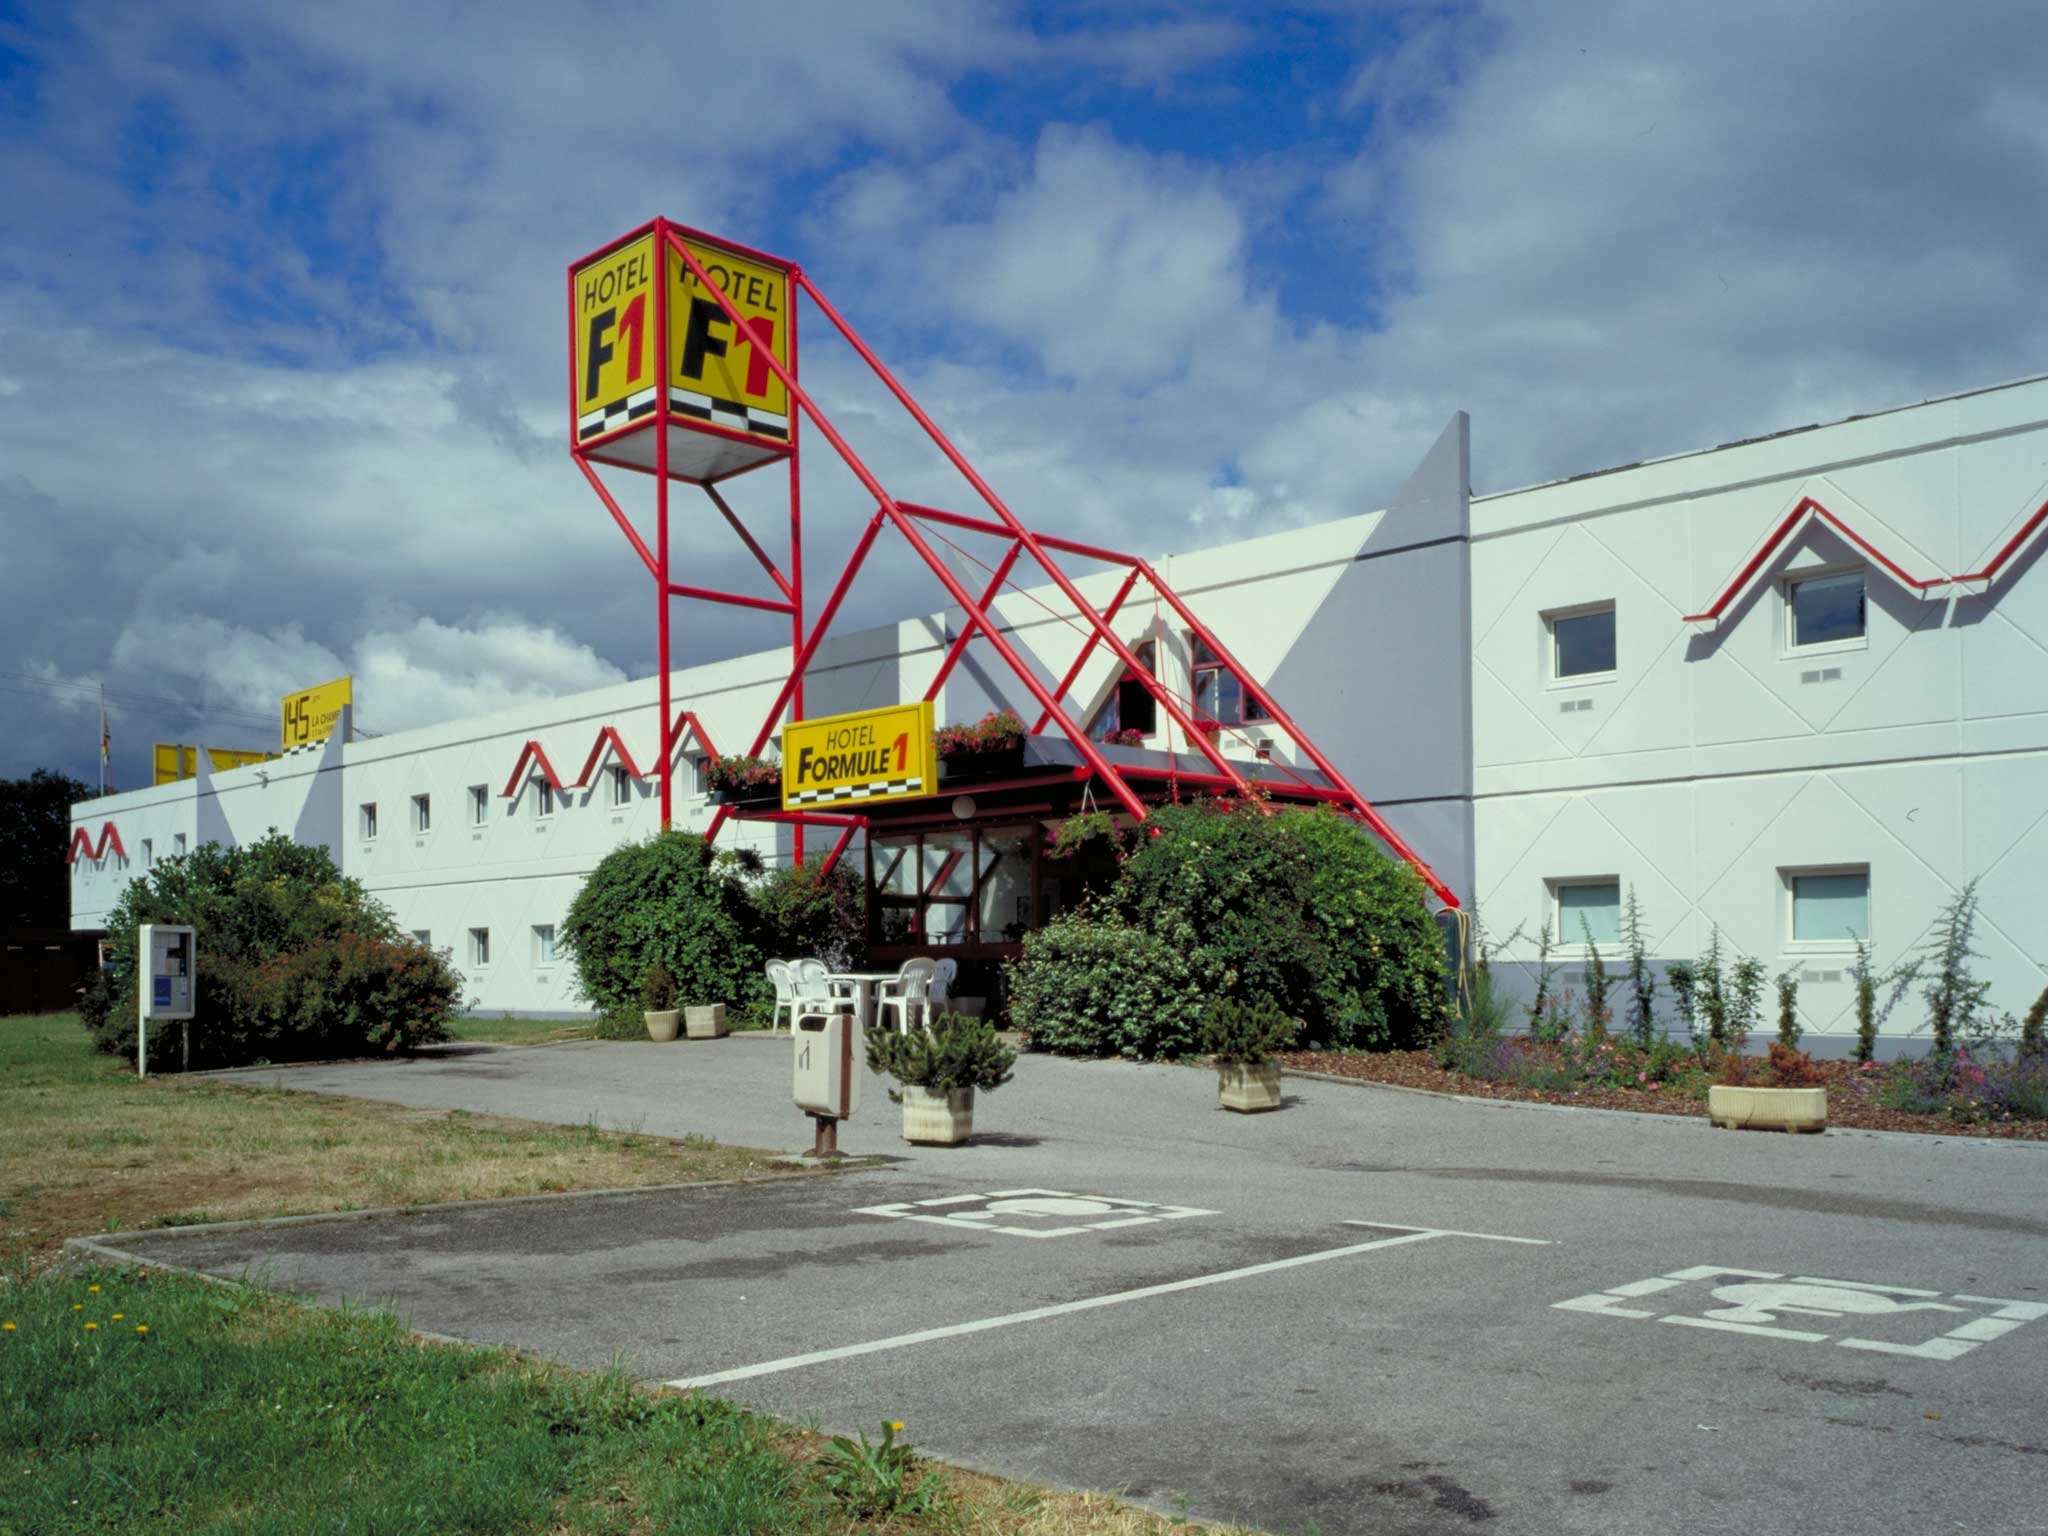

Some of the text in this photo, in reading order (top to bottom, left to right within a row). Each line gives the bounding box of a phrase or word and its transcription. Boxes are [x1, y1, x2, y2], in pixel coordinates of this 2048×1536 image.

[584, 253, 648, 313] HOTEL
[680, 258, 777, 312] HOTEL
[585, 292, 646, 402] F1
[680, 296, 775, 398] F1
[284, 695, 310, 745] 145
[826, 725, 876, 751] HOTEL
[797, 732, 908, 784] FORMULE 1
